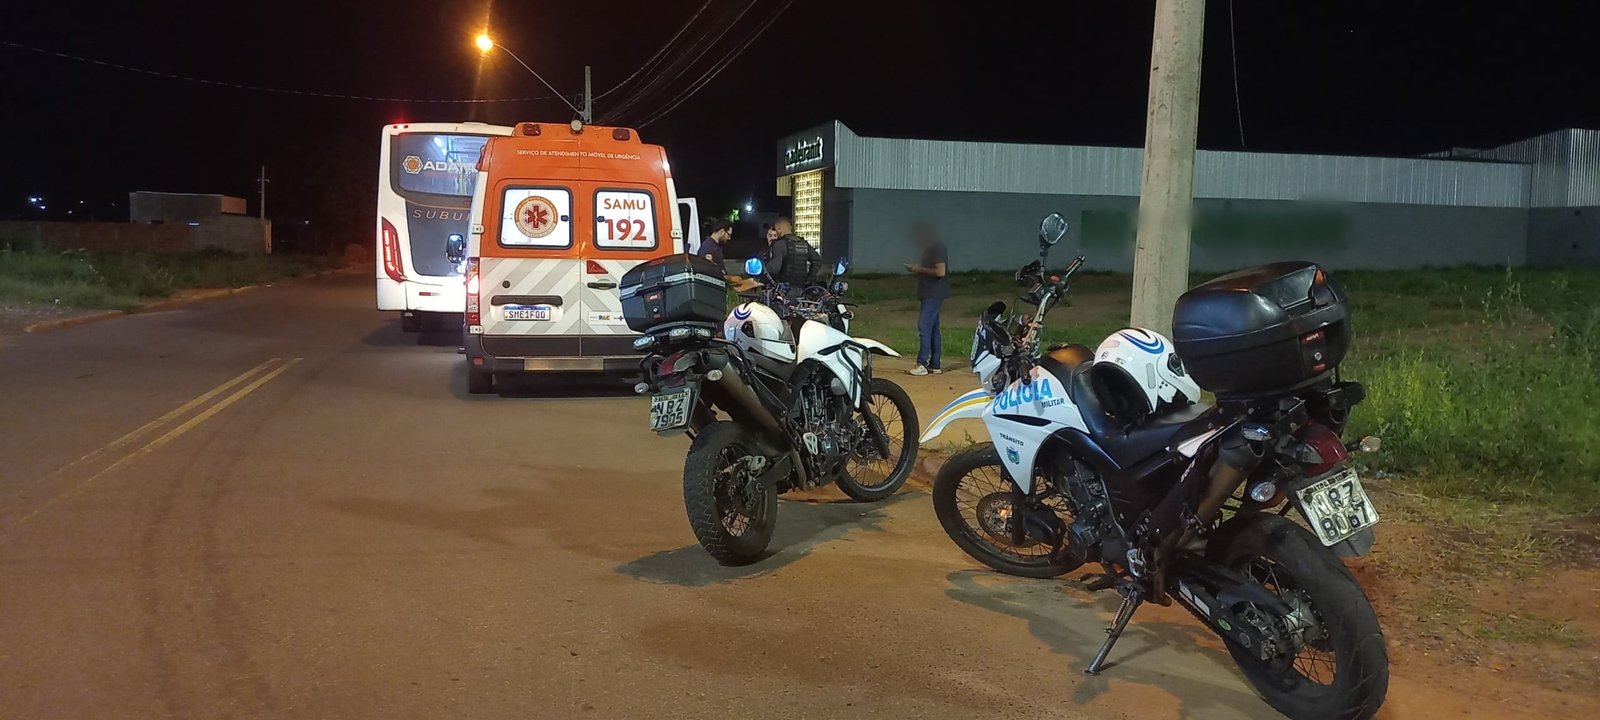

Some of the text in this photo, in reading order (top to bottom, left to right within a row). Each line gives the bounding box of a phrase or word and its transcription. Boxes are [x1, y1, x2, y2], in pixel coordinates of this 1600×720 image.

[604, 198, 646, 210] SAMU
[604, 218, 647, 241] 192
[1041, 397, 1065, 409] MILITAR
